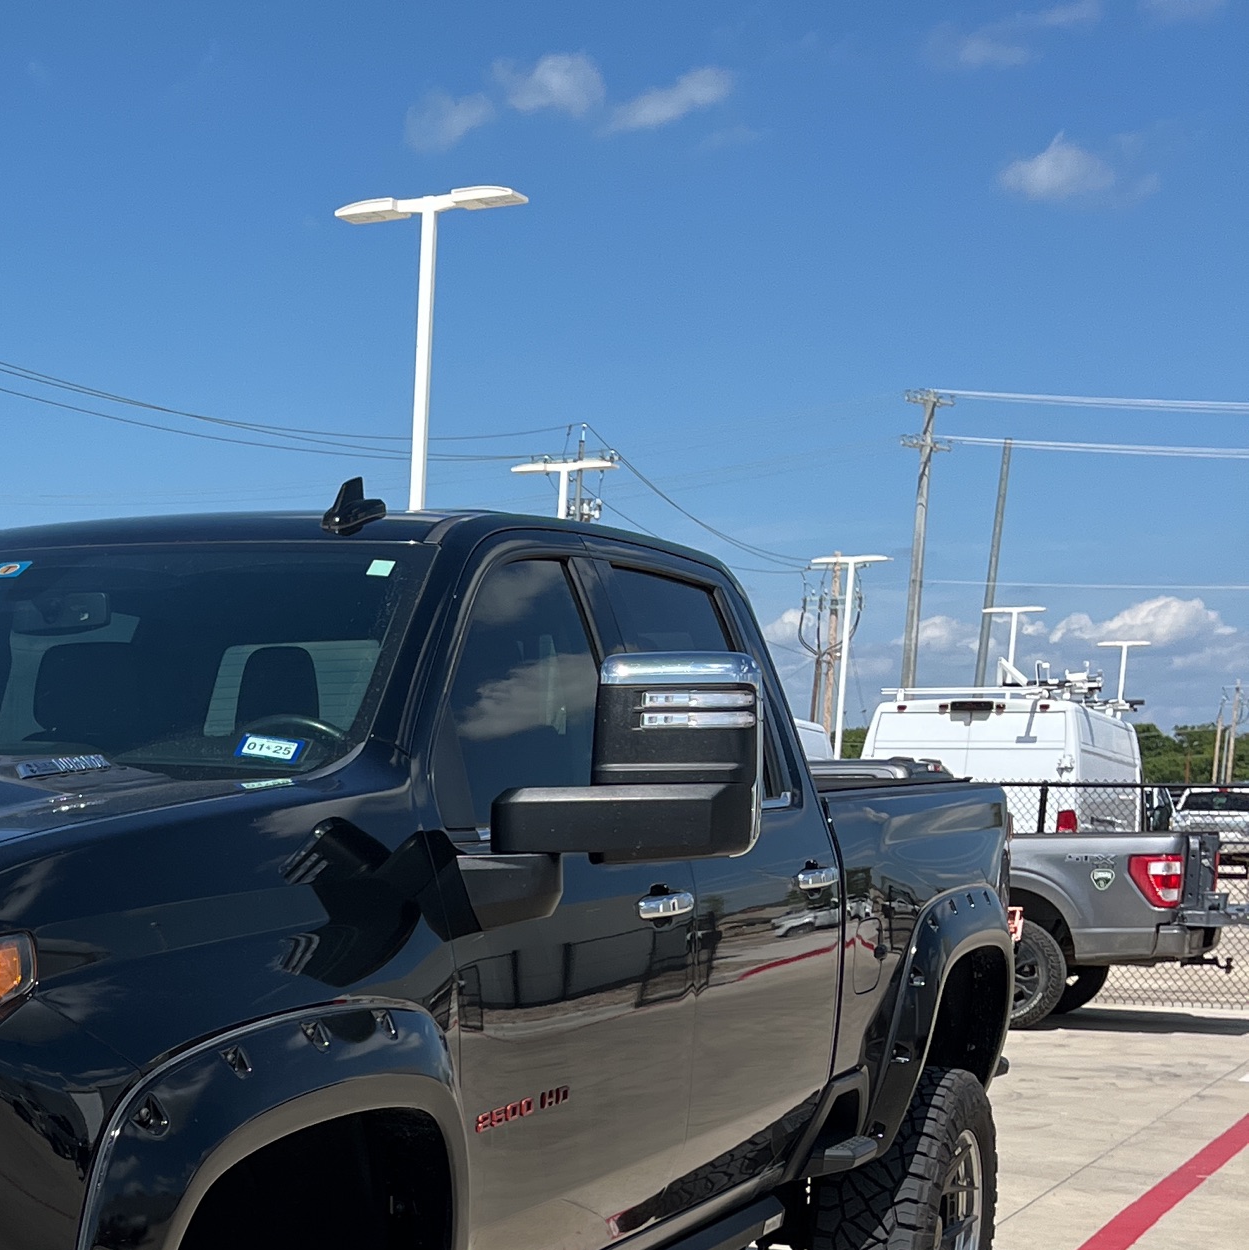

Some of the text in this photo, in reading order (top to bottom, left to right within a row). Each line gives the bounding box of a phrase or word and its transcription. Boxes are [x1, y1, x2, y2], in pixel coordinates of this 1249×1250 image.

[247, 742, 292, 756] 01 25
[475, 1085, 570, 1133] 2500 HD
